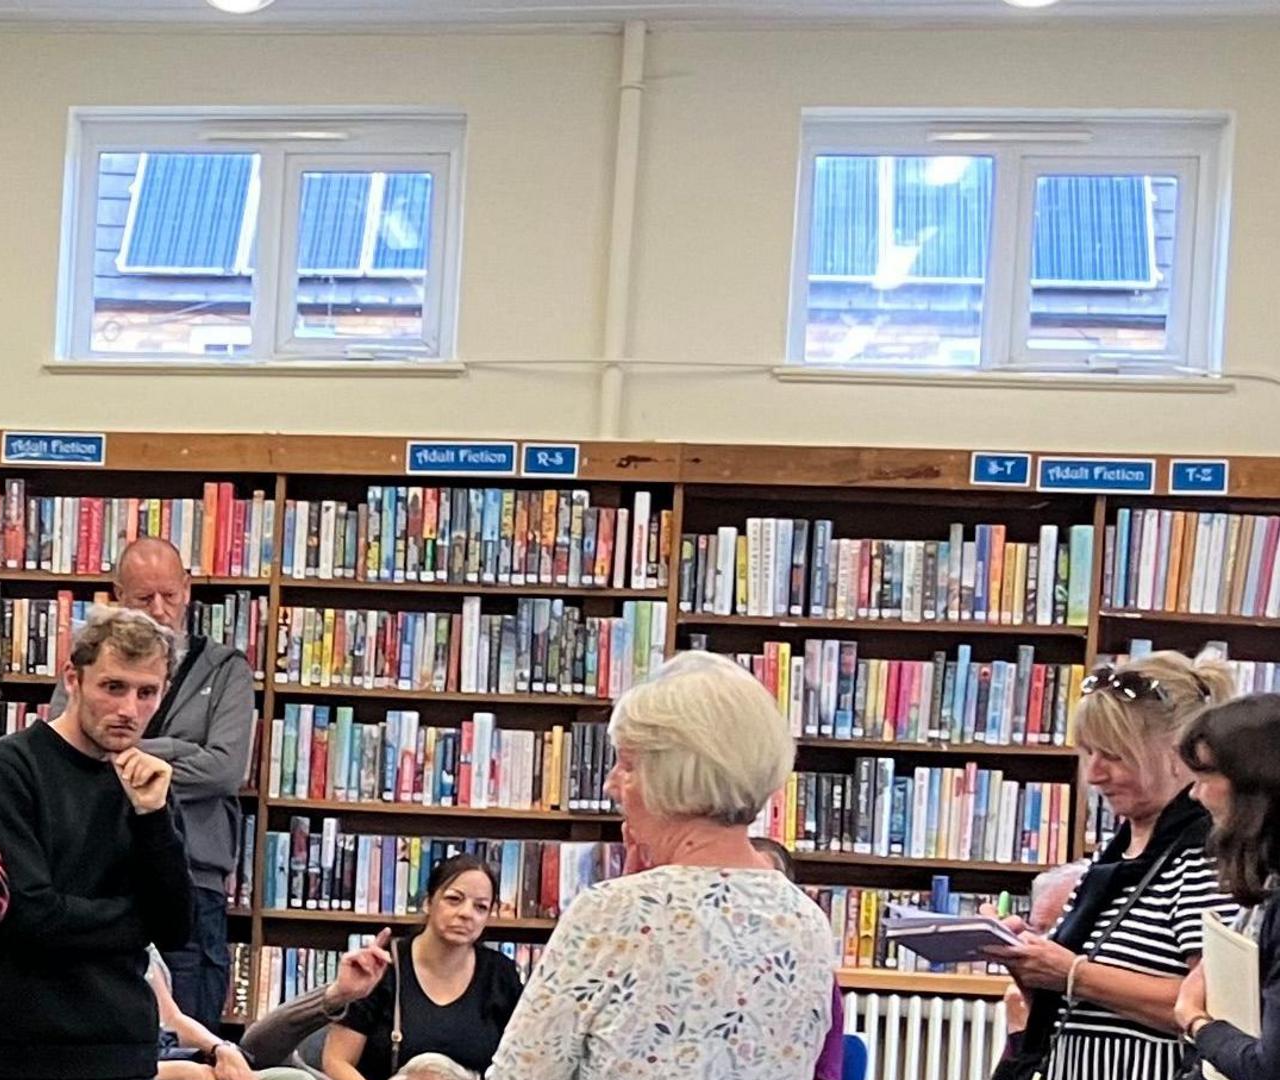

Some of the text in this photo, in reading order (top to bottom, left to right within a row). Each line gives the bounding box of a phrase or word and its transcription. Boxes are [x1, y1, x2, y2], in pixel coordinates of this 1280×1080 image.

[11, 438, 97, 455] Adult Fiction
[415, 449, 507, 464] Adult Fiction
[1048, 466, 1145, 482] Adult Fiction
